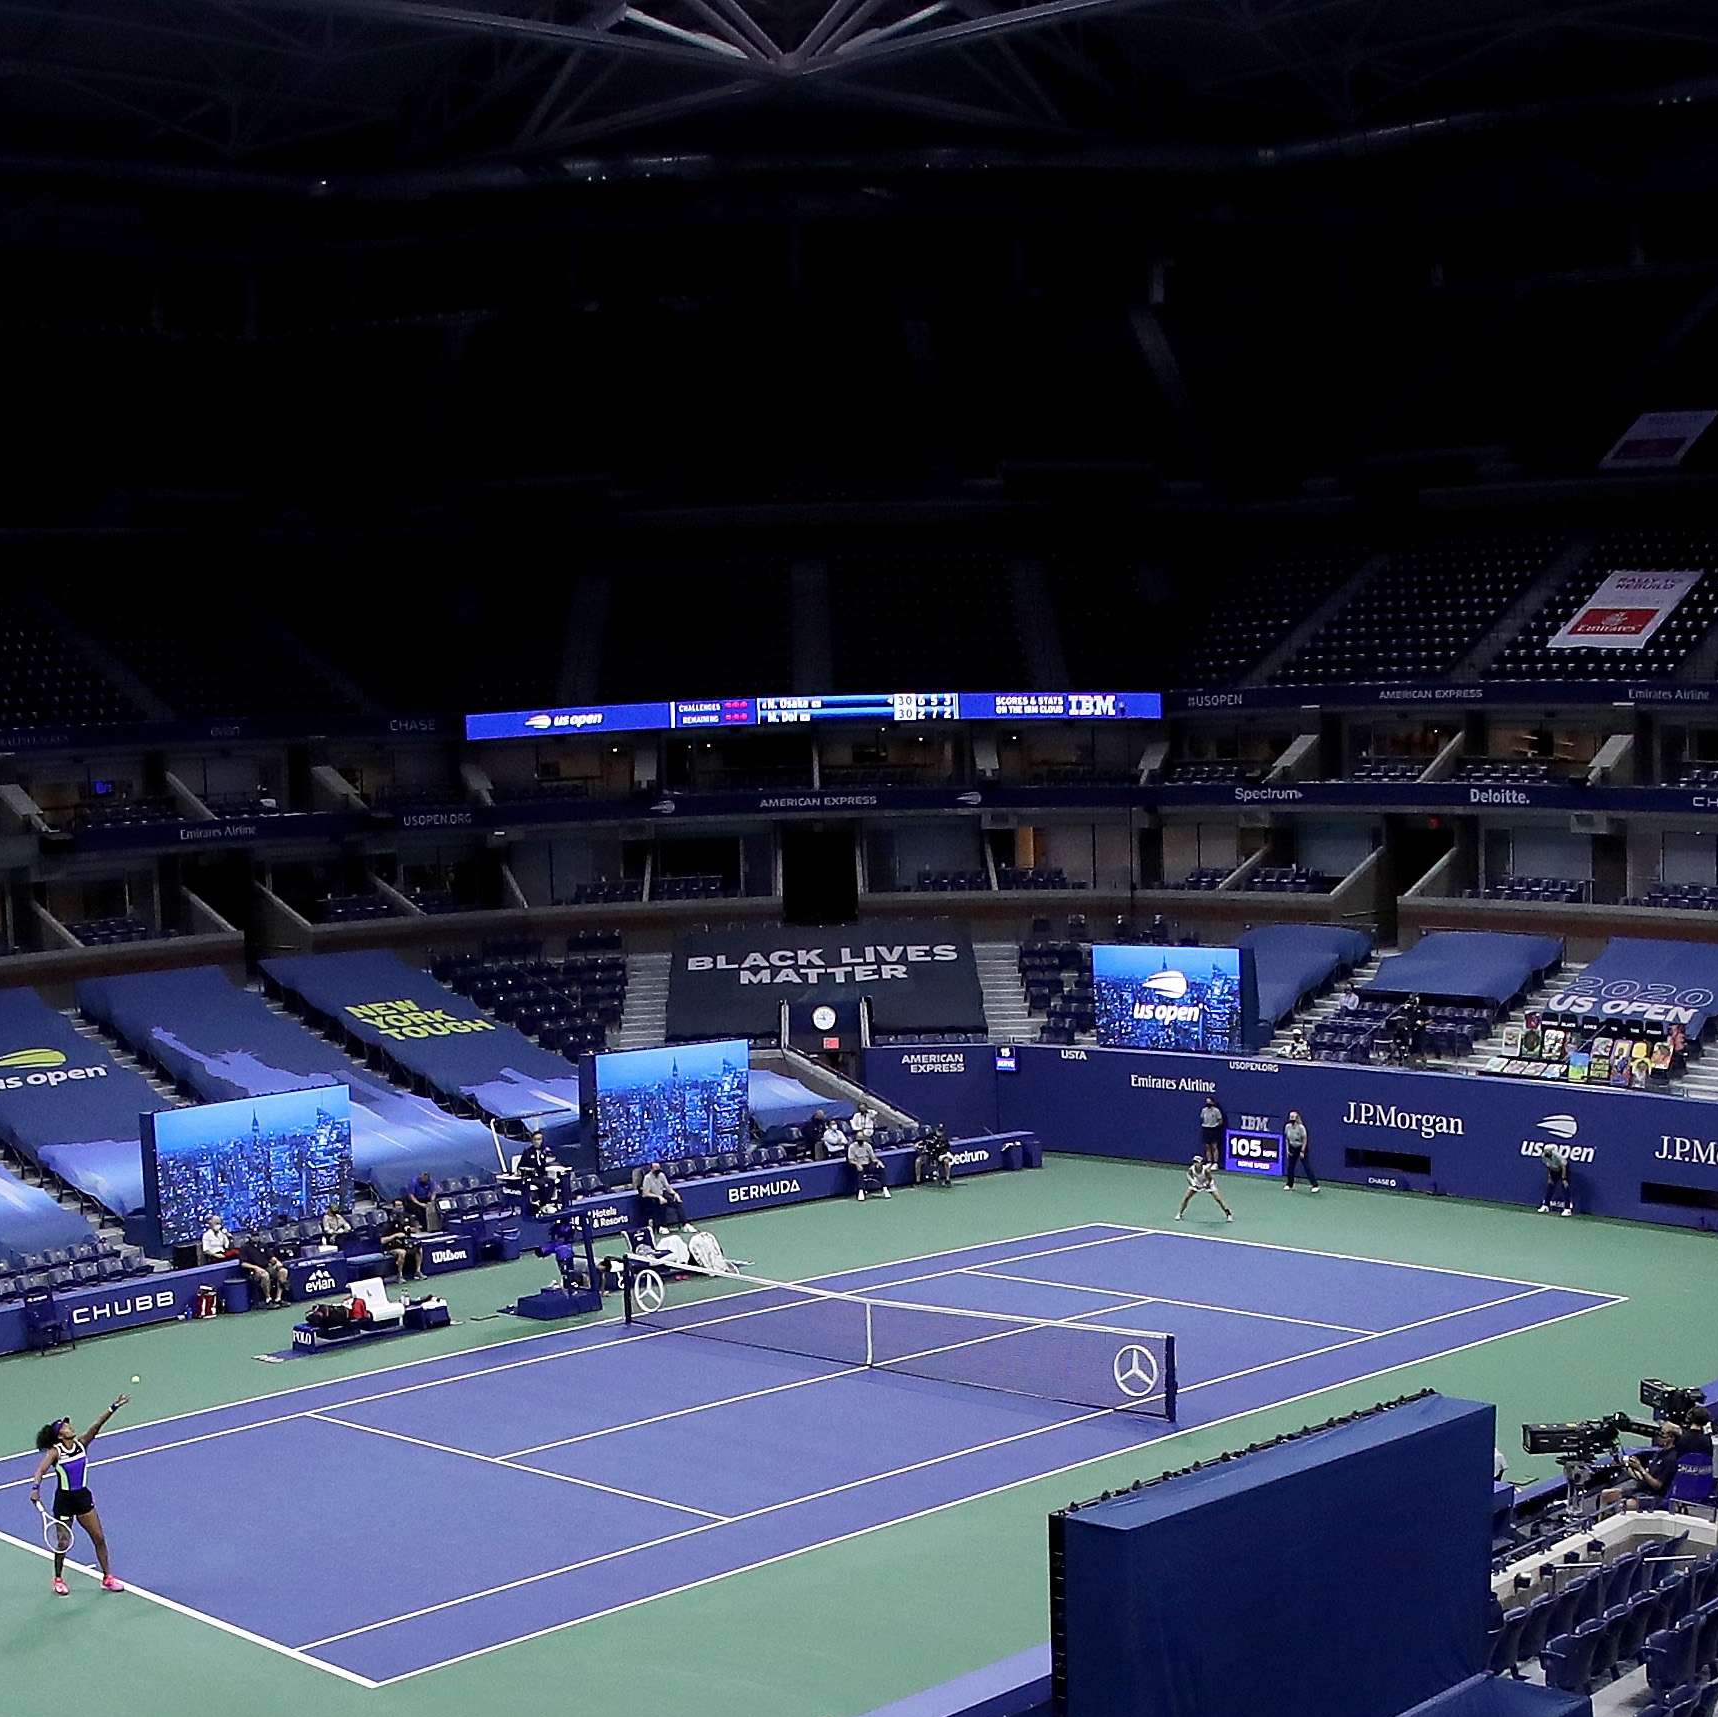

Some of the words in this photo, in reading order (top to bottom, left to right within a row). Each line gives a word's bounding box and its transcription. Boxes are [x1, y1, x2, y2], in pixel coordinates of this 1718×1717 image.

[1187, 694, 1243, 707] #USOPEN
[1379, 689, 1433, 700] AMERICAN
[1434, 688, 1483, 699] EXPRESS
[1628, 689, 1672, 700] Emirates
[1675, 688, 1711, 700] Airline
[678, 703, 721, 713] CHALLENGES
[779, 698, 809, 709] Osaka
[1068, 695, 1116, 716] IBM
[554, 714, 570, 726] us
[570, 713, 603, 728] open
[682, 715, 719, 724] REMAINING
[781, 711, 798, 722] Doi
[389, 719, 436, 731] CHASE
[759, 797, 821, 809] AMERICAN
[823, 795, 877, 807] EXPRESS
[1234, 787, 1299, 803] Spectrum
[1469, 789, 1531, 805] Deloitte.
[403, 812, 472, 827] USOPEN.ORG
[180, 826, 222, 840] Emirates
[224, 824, 257, 838] Airline
[687, 948, 823, 972] BLACK
[840, 944, 959, 964] LIVES
[739, 964, 908, 985] MATTER
[1563, 976, 1714, 1008] 2020
[344, 998, 421, 1018] NEW
[1133, 1002, 1154, 1020] us
[1154, 1004, 1200, 1026] open
[1548, 994, 1593, 1013] US
[1601, 1000, 1699, 1024] OPEN
[360, 1008, 458, 1029] YORK
[378, 1018, 496, 1041] TOUGH
[901, 1053, 964, 1064] AMERICAN
[1061, 1050, 1087, 1061] USTA
[910, 1063, 965, 1073] EXPRESS
[1229, 1061, 1279, 1073] USOPEN.ORG
[25, 1066, 108, 1086] open
[1130, 1074, 1177, 1090] Emirates
[1178, 1077, 1216, 1093] Airline
[1241, 1115, 1269, 1132] IBM
[1343, 1102, 1465, 1139] J.P.Morgan
[1230, 1137, 1262, 1157] 105
[1520, 1140, 1543, 1157] us
[1369, 1177, 1390, 1186] CHASE
[728, 1180, 801, 1202] BERMUDA
[592, 1206, 617, 1218] Hotels
[600, 1215, 629, 1228] Resorts
[432, 1248, 467, 1263] Wilson
[305, 1278, 335, 1292] evian
[72, 1291, 174, 1324] CHUBB
[293, 1330, 311, 1345] POLO
